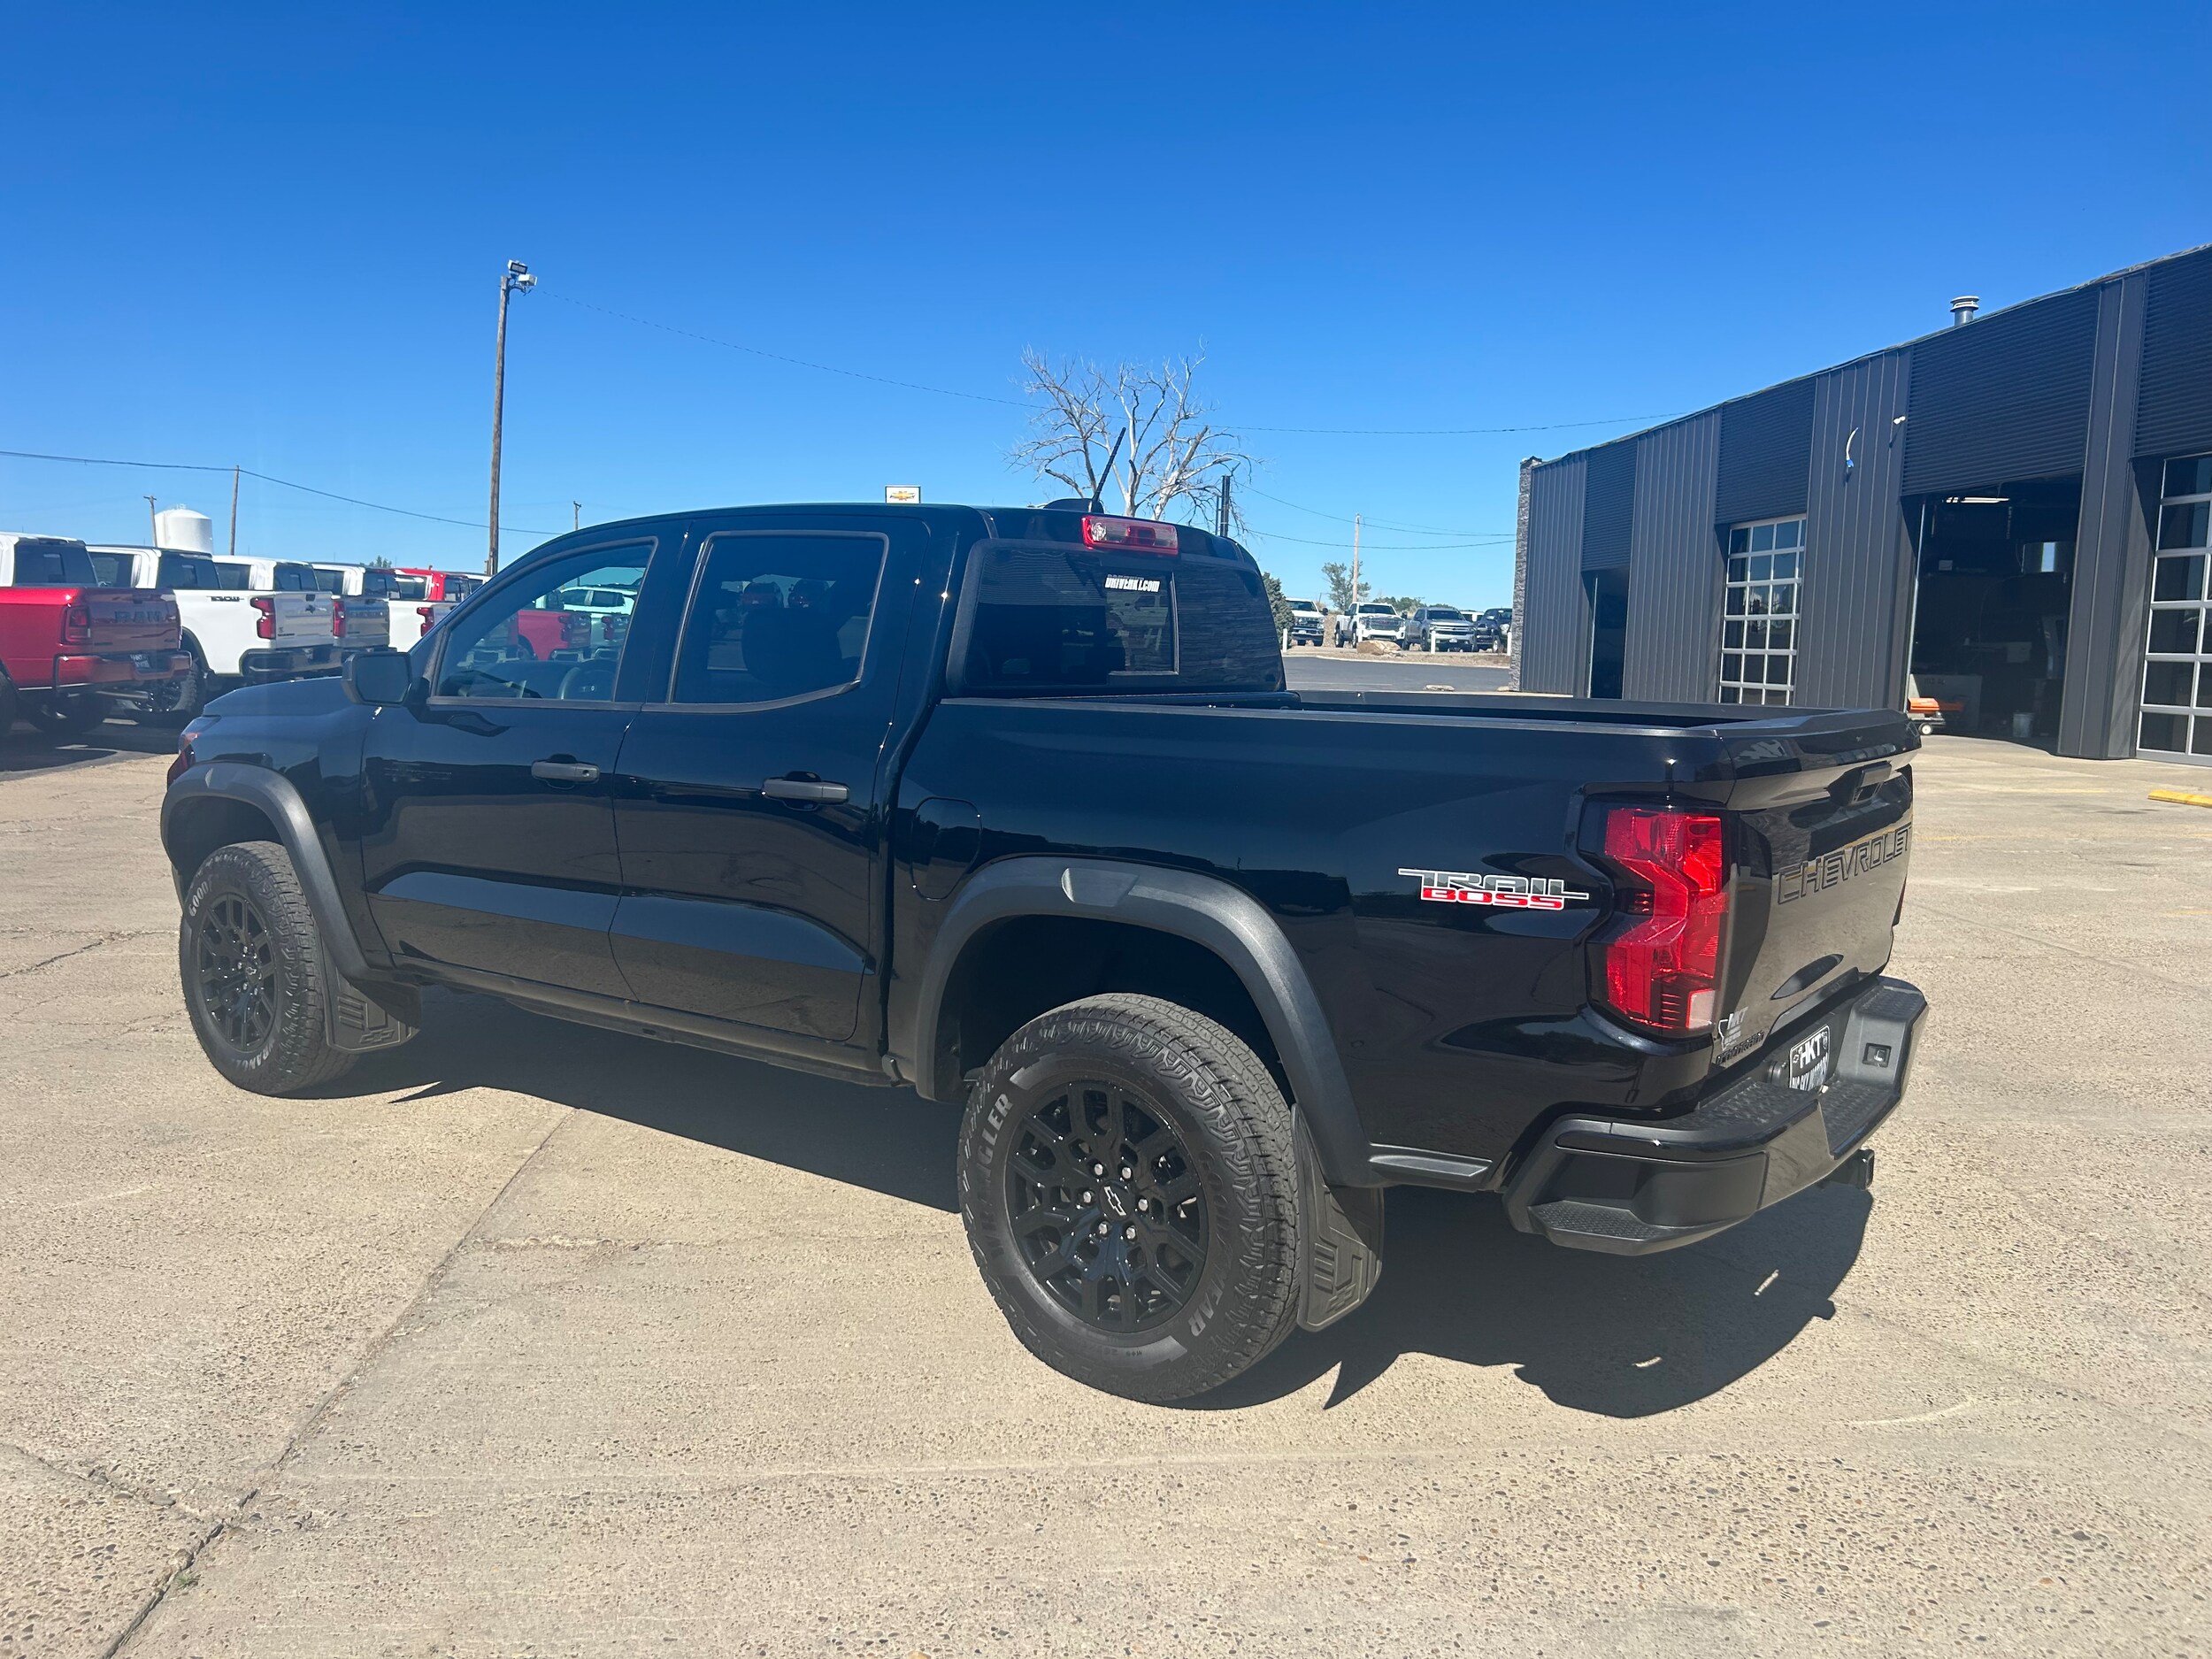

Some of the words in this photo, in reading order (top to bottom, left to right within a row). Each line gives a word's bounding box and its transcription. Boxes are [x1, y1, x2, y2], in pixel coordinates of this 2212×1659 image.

[1778, 822, 1912, 905] CHEVROLET
[1398, 868, 1590, 901] TRAIL
[1420, 887, 1564, 910] BOSS
[1797, 1034, 1822, 1069] HKT
